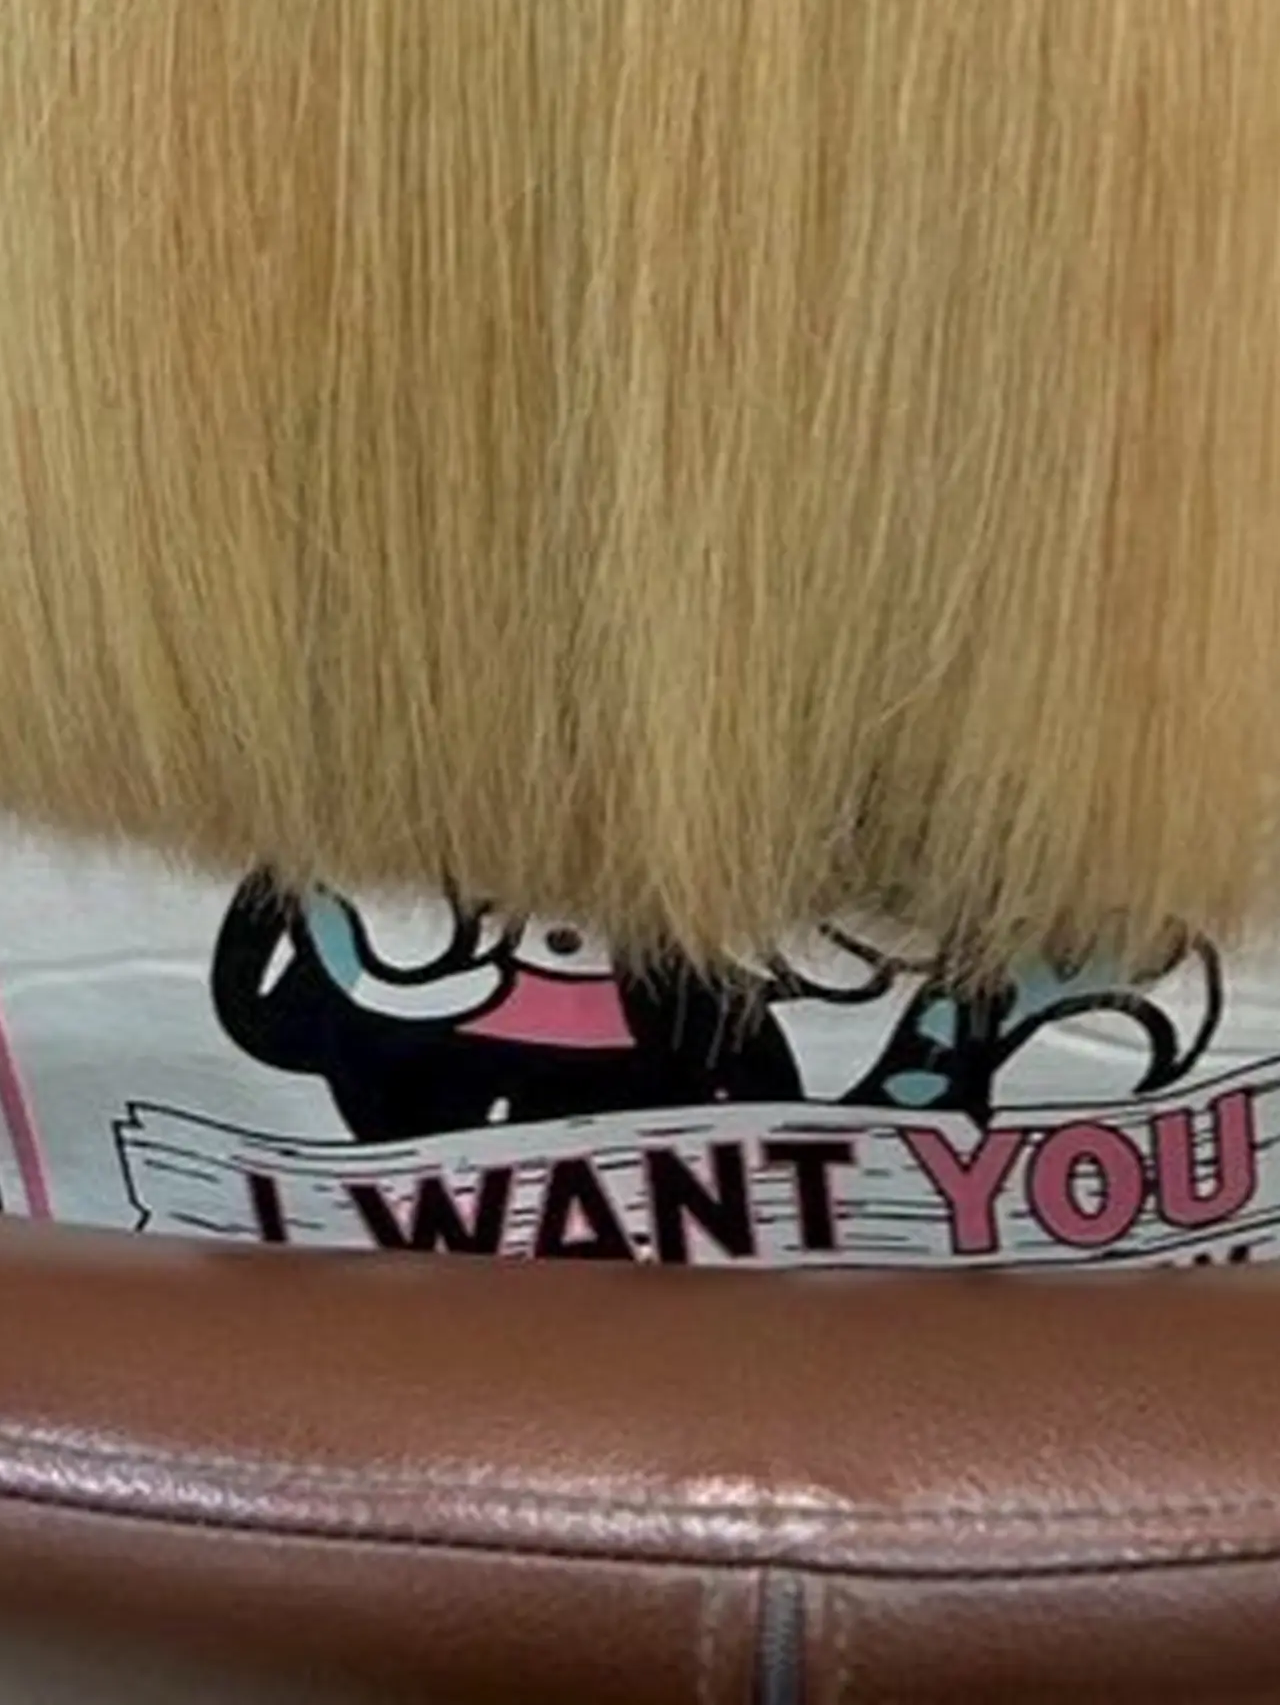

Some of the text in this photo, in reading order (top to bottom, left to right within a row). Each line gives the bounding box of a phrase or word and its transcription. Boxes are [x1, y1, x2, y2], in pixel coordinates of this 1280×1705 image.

[243, 1084, 1258, 1264] I WANT YOU
